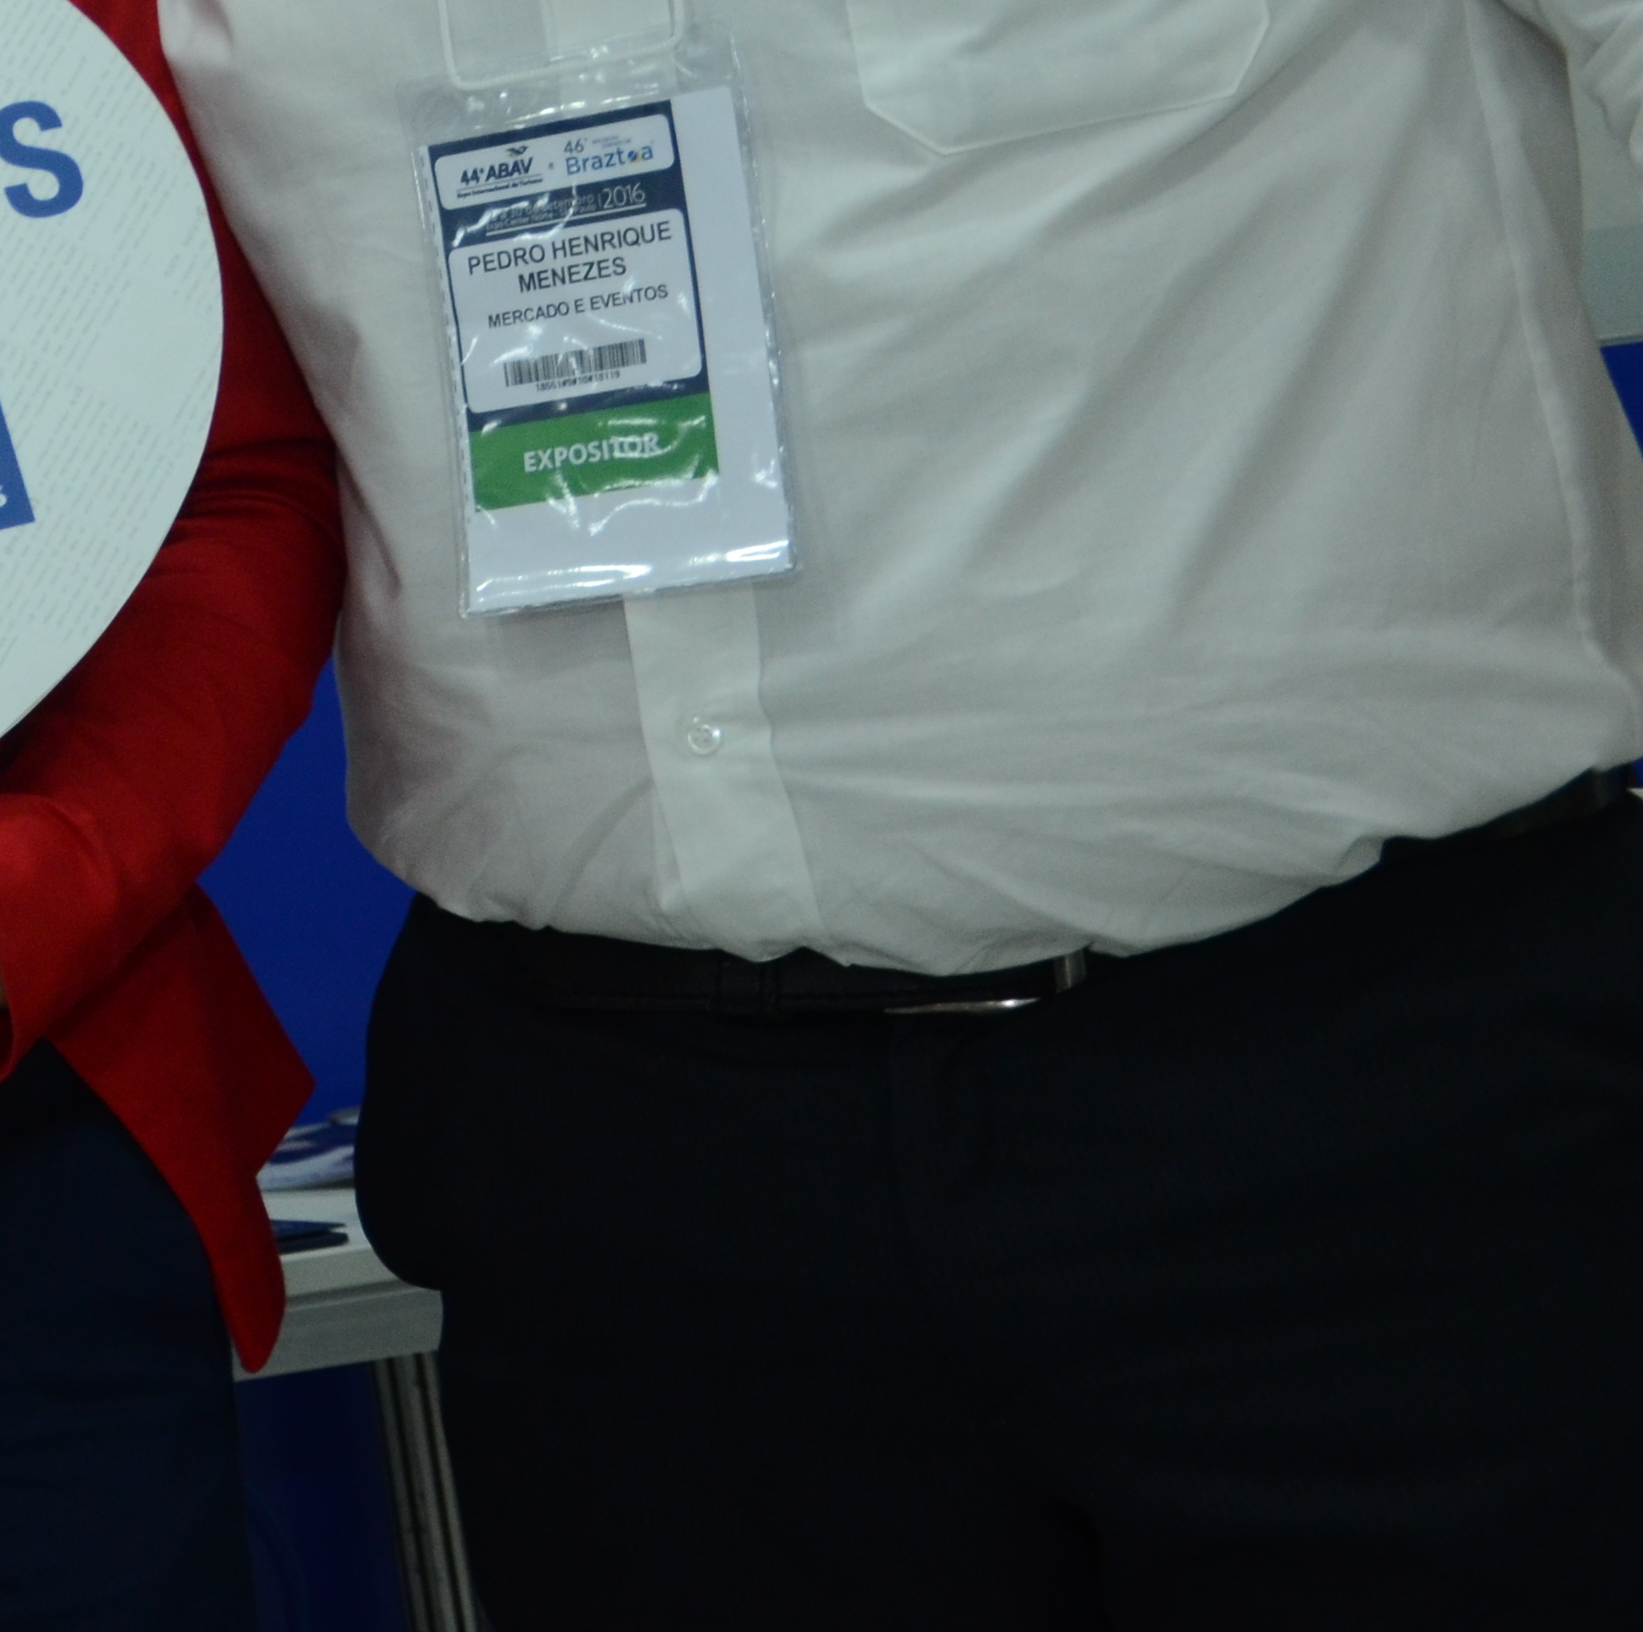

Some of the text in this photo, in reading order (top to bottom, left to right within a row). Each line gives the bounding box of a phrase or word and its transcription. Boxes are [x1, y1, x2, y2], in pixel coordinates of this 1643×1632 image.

[603, 182, 646, 210] 2016
[468, 220, 672, 276] PEDRO HENRIQUE
[518, 256, 627, 293] MENEZES
[488, 284, 669, 329] MERCADO E EVENTOS
[523, 432, 662, 473] EXPOSITOR
